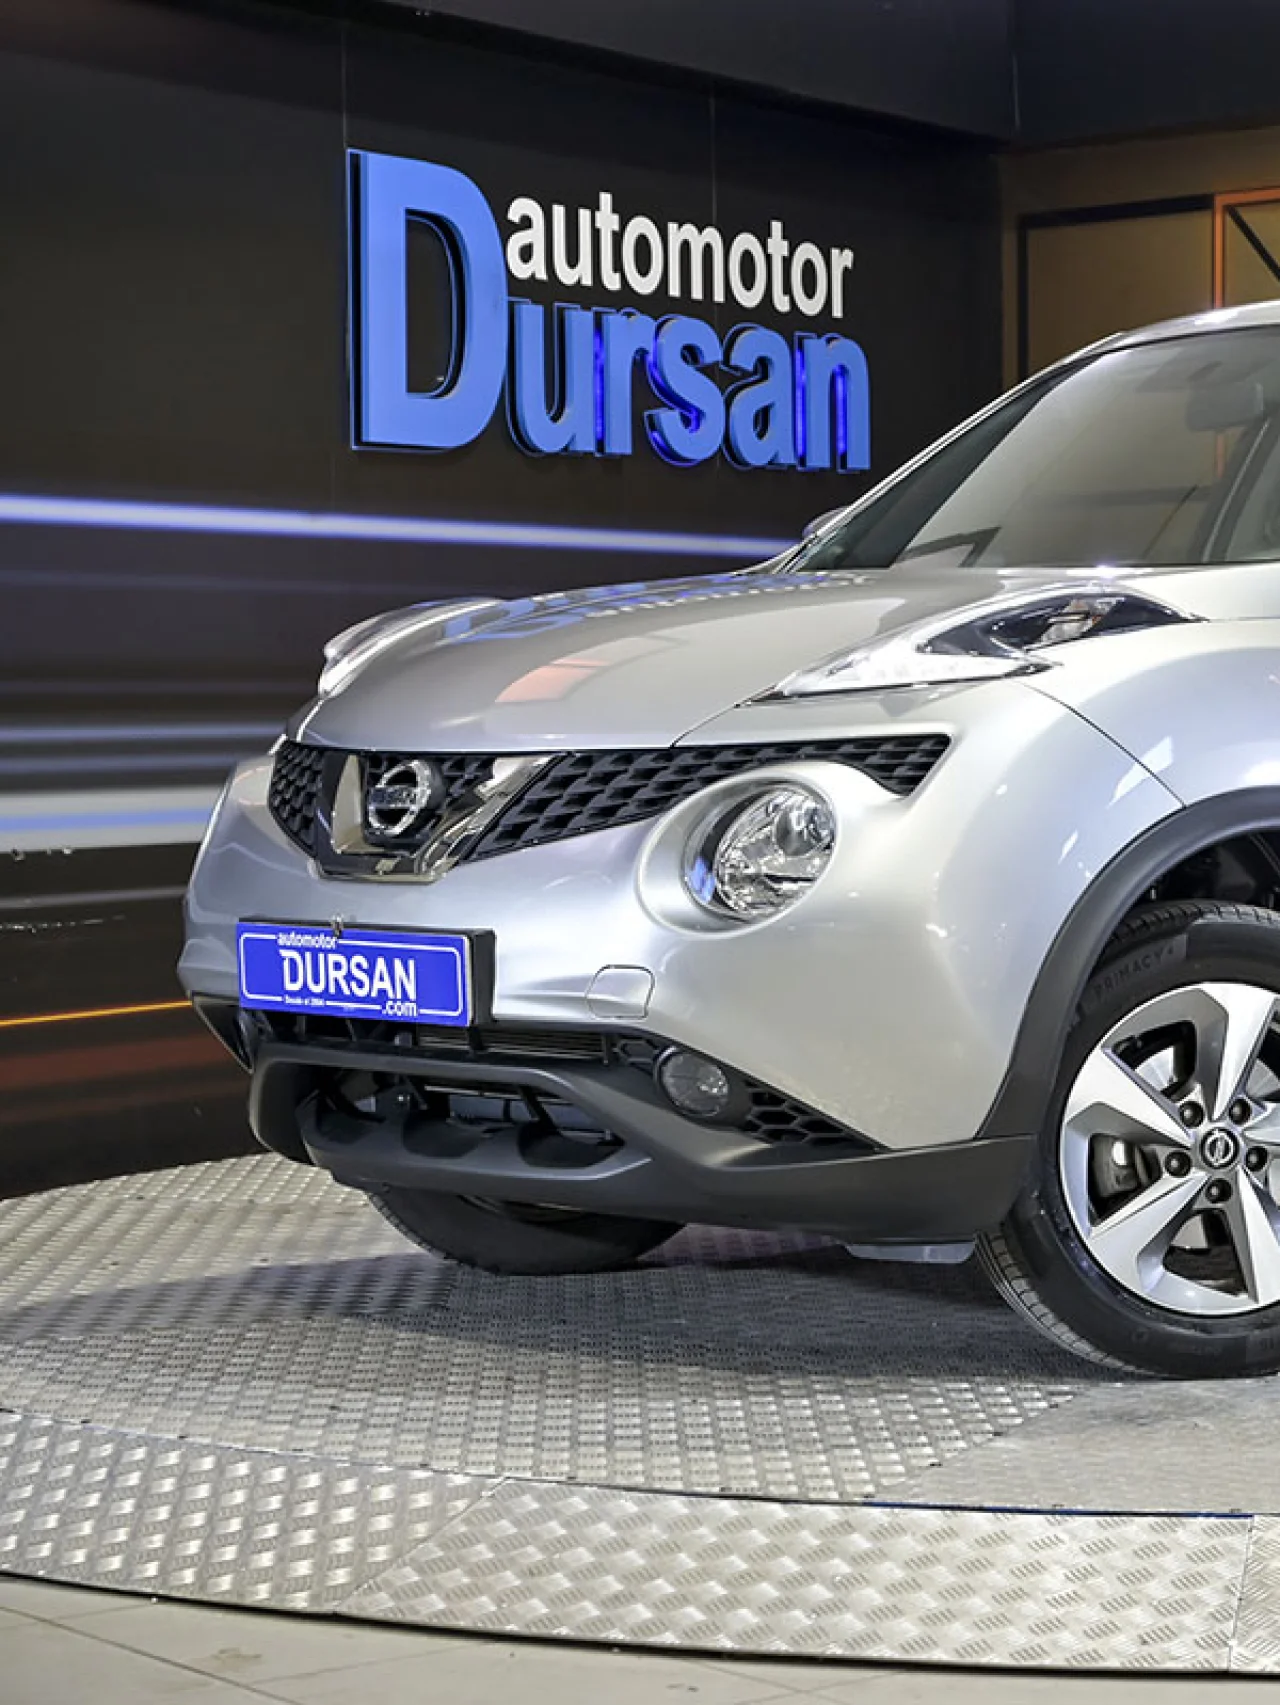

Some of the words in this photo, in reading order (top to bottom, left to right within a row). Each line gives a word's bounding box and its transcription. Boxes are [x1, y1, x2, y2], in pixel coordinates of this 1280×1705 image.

[506, 191, 854, 318] automotor
[347, 148, 871, 471] Dursan
[277, 931, 338, 949] automotor
[279, 949, 417, 1000] DURSAN
[381, 1000, 418, 1017] .com
